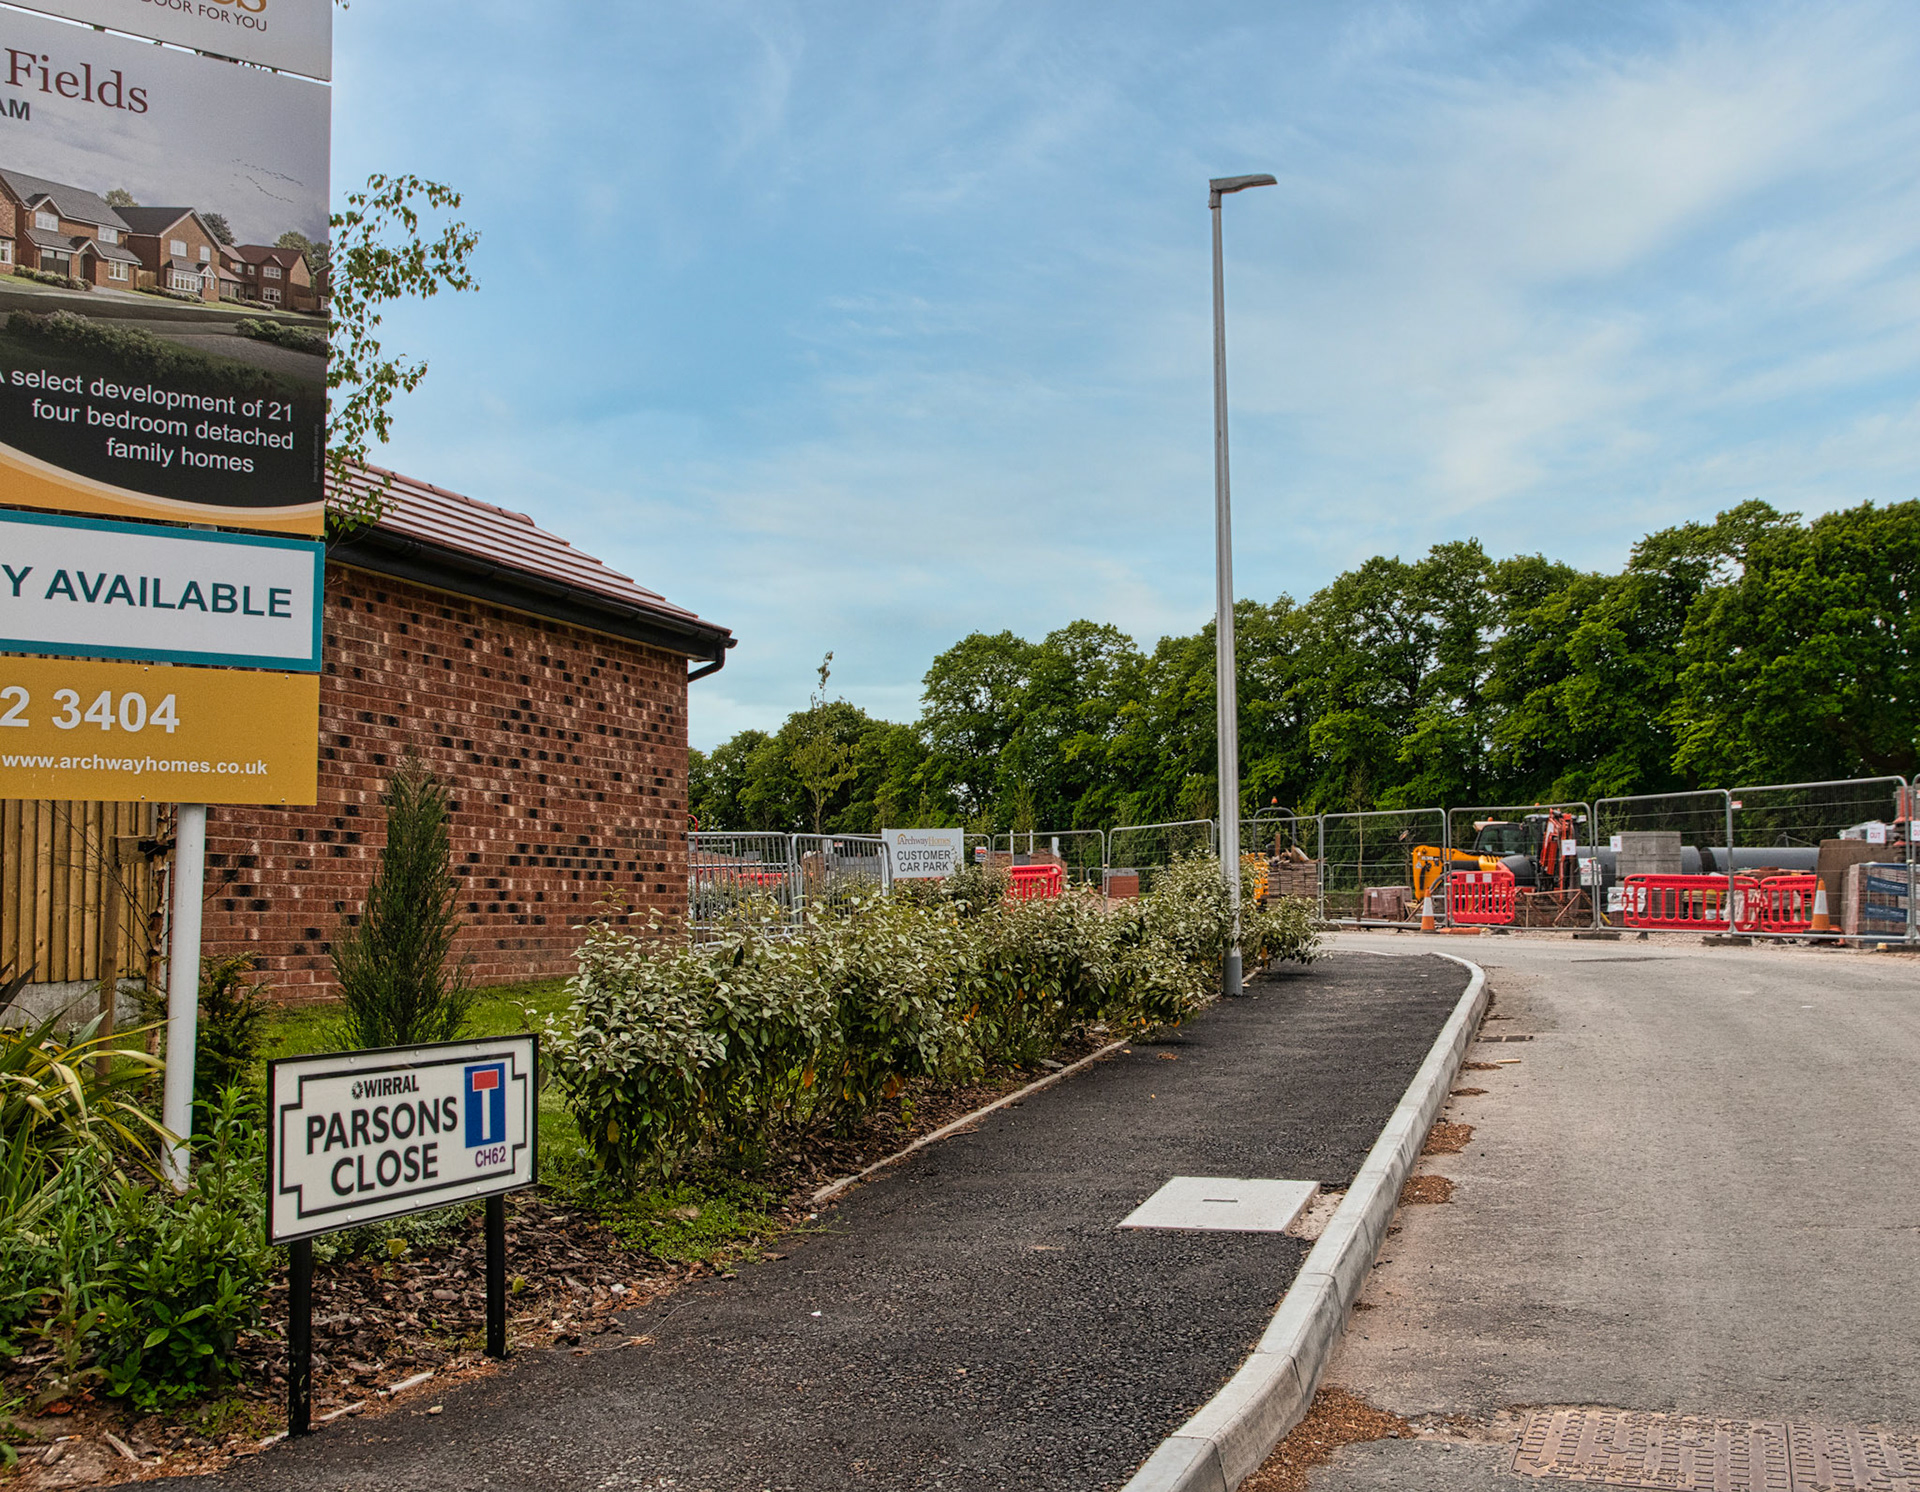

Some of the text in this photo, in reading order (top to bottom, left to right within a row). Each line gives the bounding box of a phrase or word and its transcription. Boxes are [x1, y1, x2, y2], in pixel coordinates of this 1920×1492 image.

[142, 0, 193, 14] OOR
[199, 4, 230, 23] FOR
[233, 12, 267, 32] YOU
[4, 47, 149, 114] Fields
[11, 369, 83, 394] select
[90, 378, 236, 415] development
[242, 399, 264, 418] of
[269, 402, 293, 422] 21
[32, 398, 294, 450] four bedroom detached
[106, 437, 255, 473] family homes
[1, 564, 292, 619] Y AVAILABLE
[0, 686, 180, 734] 2 3404
[2, 754, 268, 775] www.archwayhomes.co.uk
[897, 850, 951, 861] CUSTOMER
[900, 862, 949, 872] CAR PARK
[363, 1074, 420, 1099] WIRRAL
[306, 1096, 458, 1155] PARSONS
[331, 1142, 439, 1196] CLOSE
[475, 1146, 506, 1168] CH62
